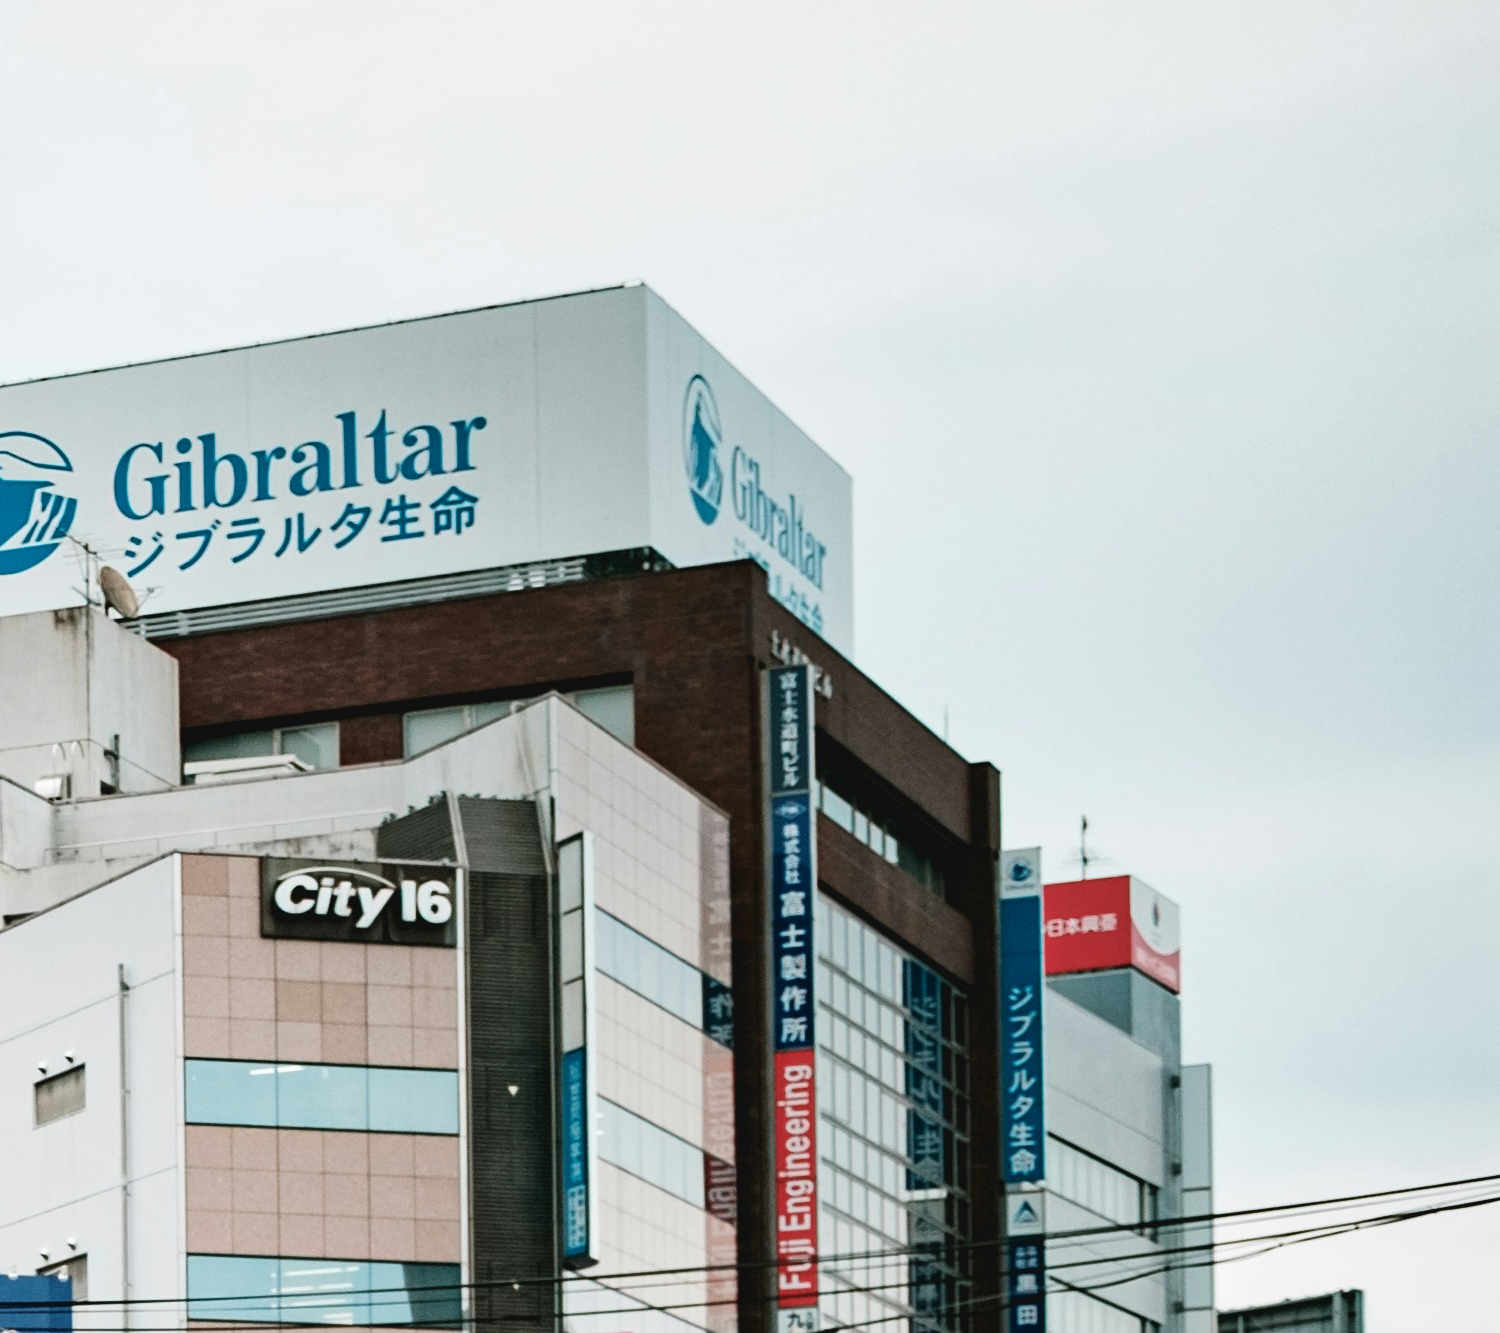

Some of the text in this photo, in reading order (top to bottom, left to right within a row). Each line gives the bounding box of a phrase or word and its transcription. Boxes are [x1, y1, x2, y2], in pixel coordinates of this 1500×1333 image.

[113, 409, 487, 522] Gibraltar
[731, 445, 827, 592] Gibraltar
[125, 487, 479, 577] ジブラルタ生命
[274, 866, 454, 930] City 16
[779, 889, 808, 1046] 富士製作所
[1008, 985, 1038, 1177] ジブラルタ生命
[779, 1064, 814, 1231] Engineering
[779, 1237, 813, 1292] Fuji
